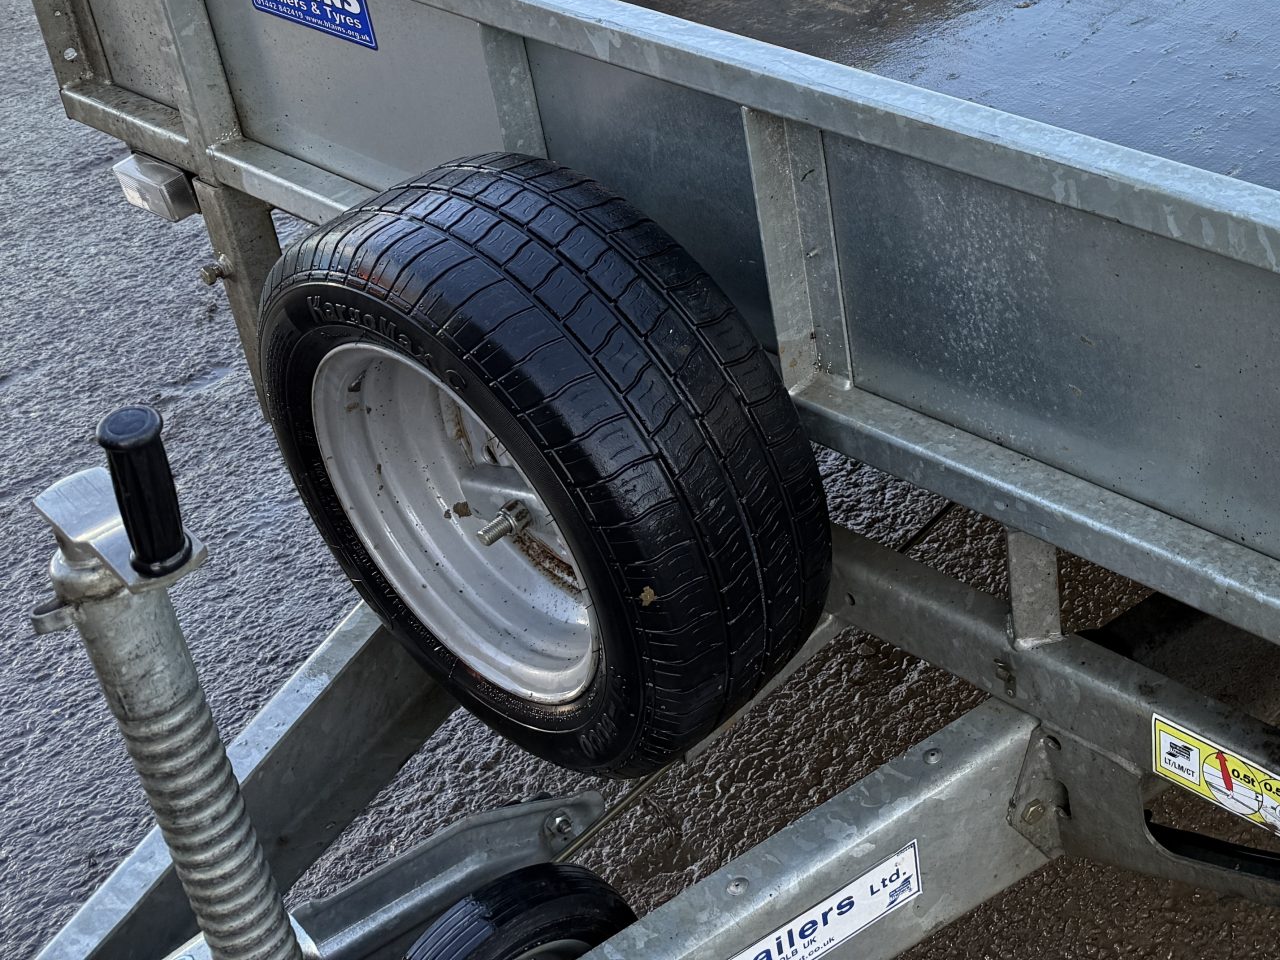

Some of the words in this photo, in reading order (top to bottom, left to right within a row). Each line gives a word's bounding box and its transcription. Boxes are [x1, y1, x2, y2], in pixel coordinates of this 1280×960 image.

[311, 1, 321, 15] &
[323, 5, 363, 29] Tyres
[304, 14, 371, 41] www.blains.org.uk
[1164, 756, 1196, 778] LT/LM/CT
[1231, 768, 1257, 788] 0.5t
[869, 867, 907, 897] Ltd.
[803, 935, 817, 950] UK
